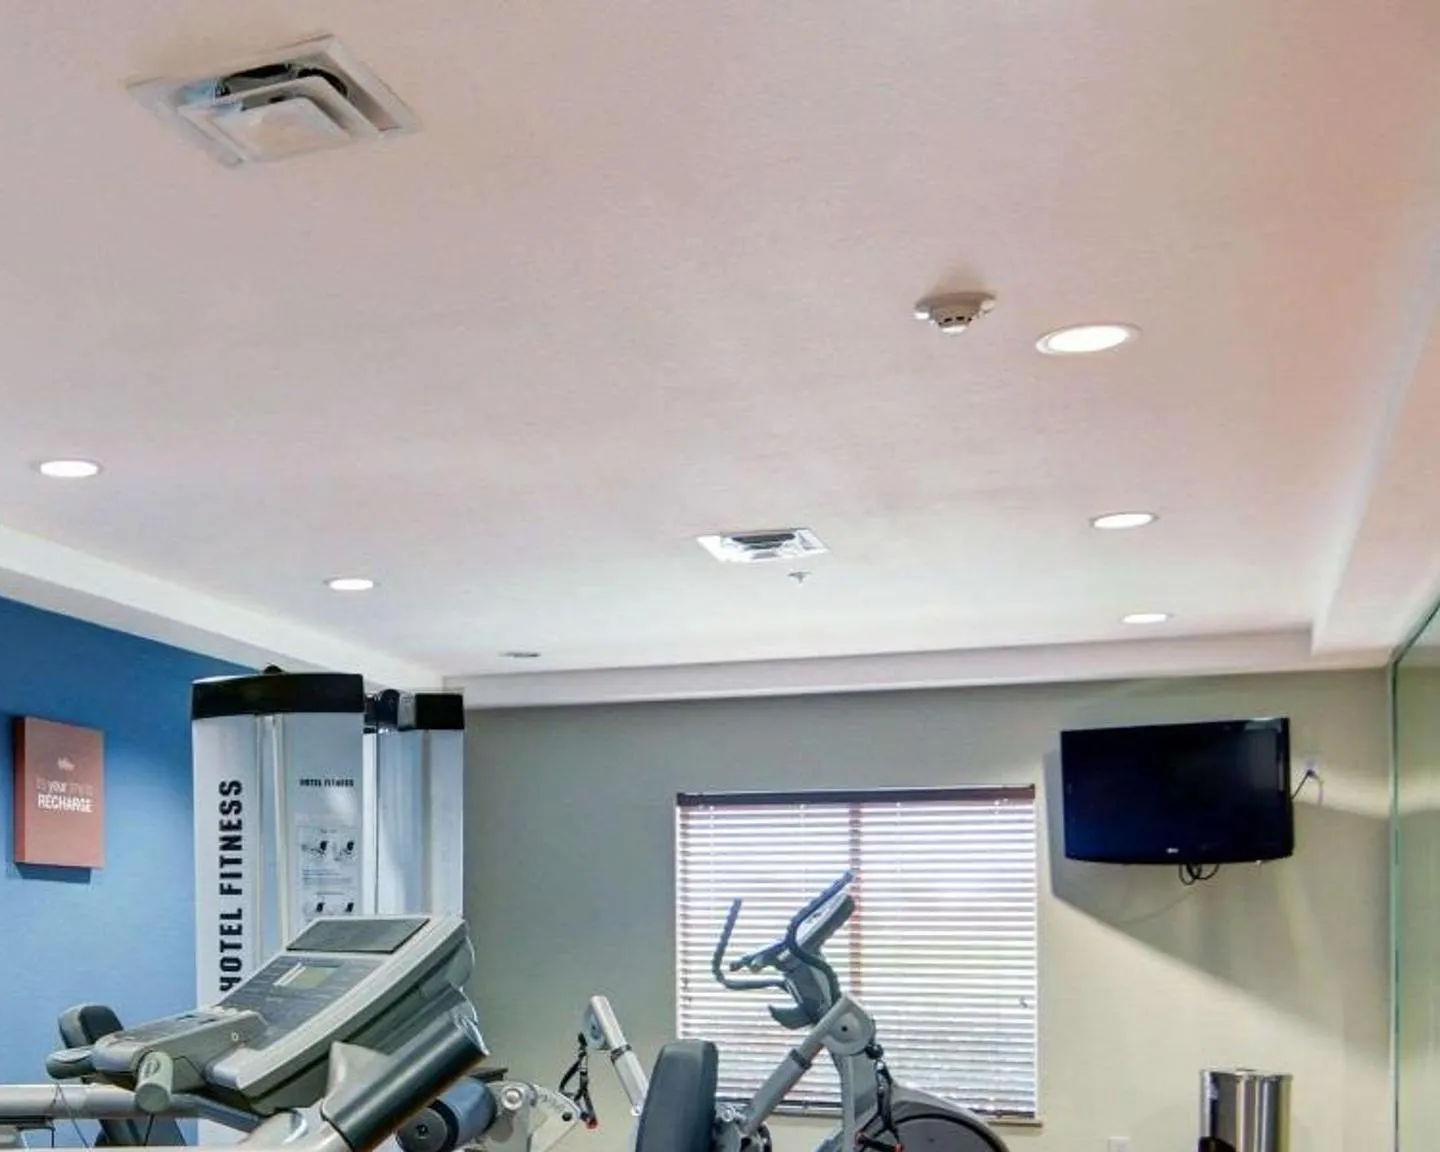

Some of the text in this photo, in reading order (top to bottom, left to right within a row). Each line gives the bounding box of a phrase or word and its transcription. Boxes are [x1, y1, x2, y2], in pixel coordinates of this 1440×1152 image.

[38, 793, 93, 813] RECHARGE
[219, 780, 243, 992] HOTEL FITNESS
